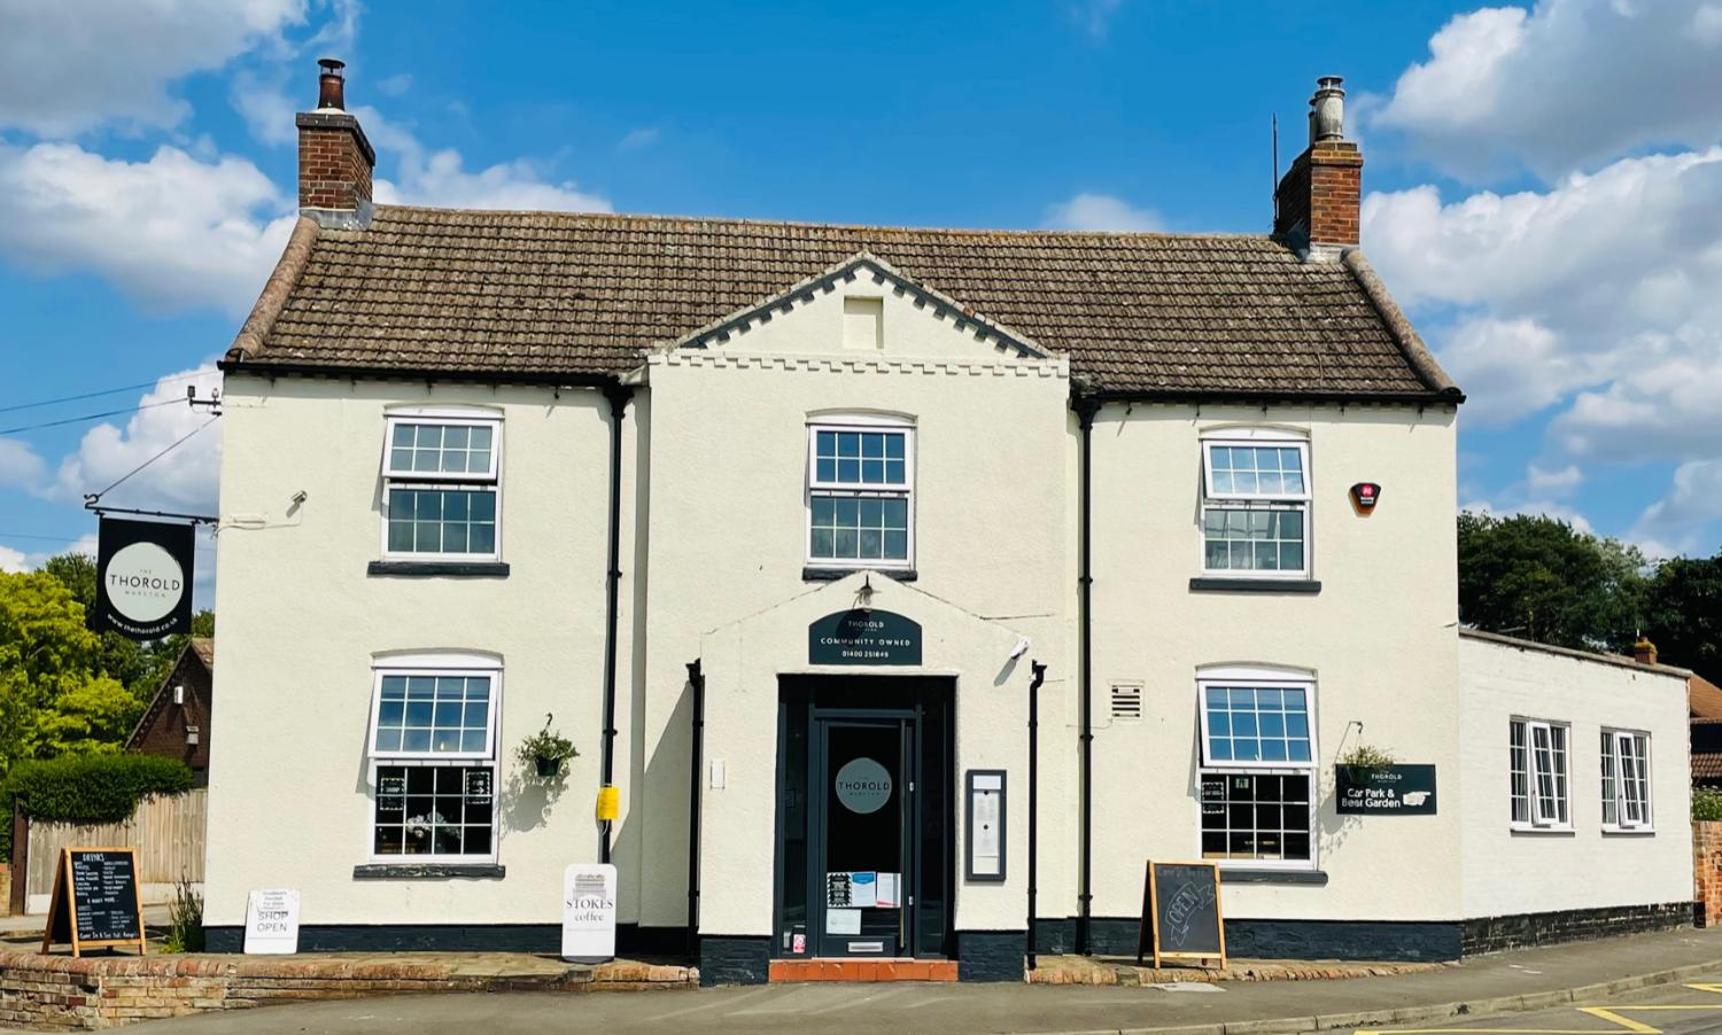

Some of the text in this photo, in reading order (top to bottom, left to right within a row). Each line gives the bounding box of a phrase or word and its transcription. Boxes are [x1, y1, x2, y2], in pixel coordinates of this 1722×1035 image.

[109, 574, 180, 591] THOROLD
[847, 620, 885, 628] THOROLD
[820, 638, 911, 646] COMMUNITY OWNED
[838, 782, 890, 790] THOROLD
[1347, 788, 1395, 798] Car Park &
[1365, 798, 1401, 808] Garden
[566, 899, 613, 910] STOKES
[257, 911, 289, 920] SHOP
[574, 911, 605, 921] coffee
[257, 922, 288, 932] OPEN
